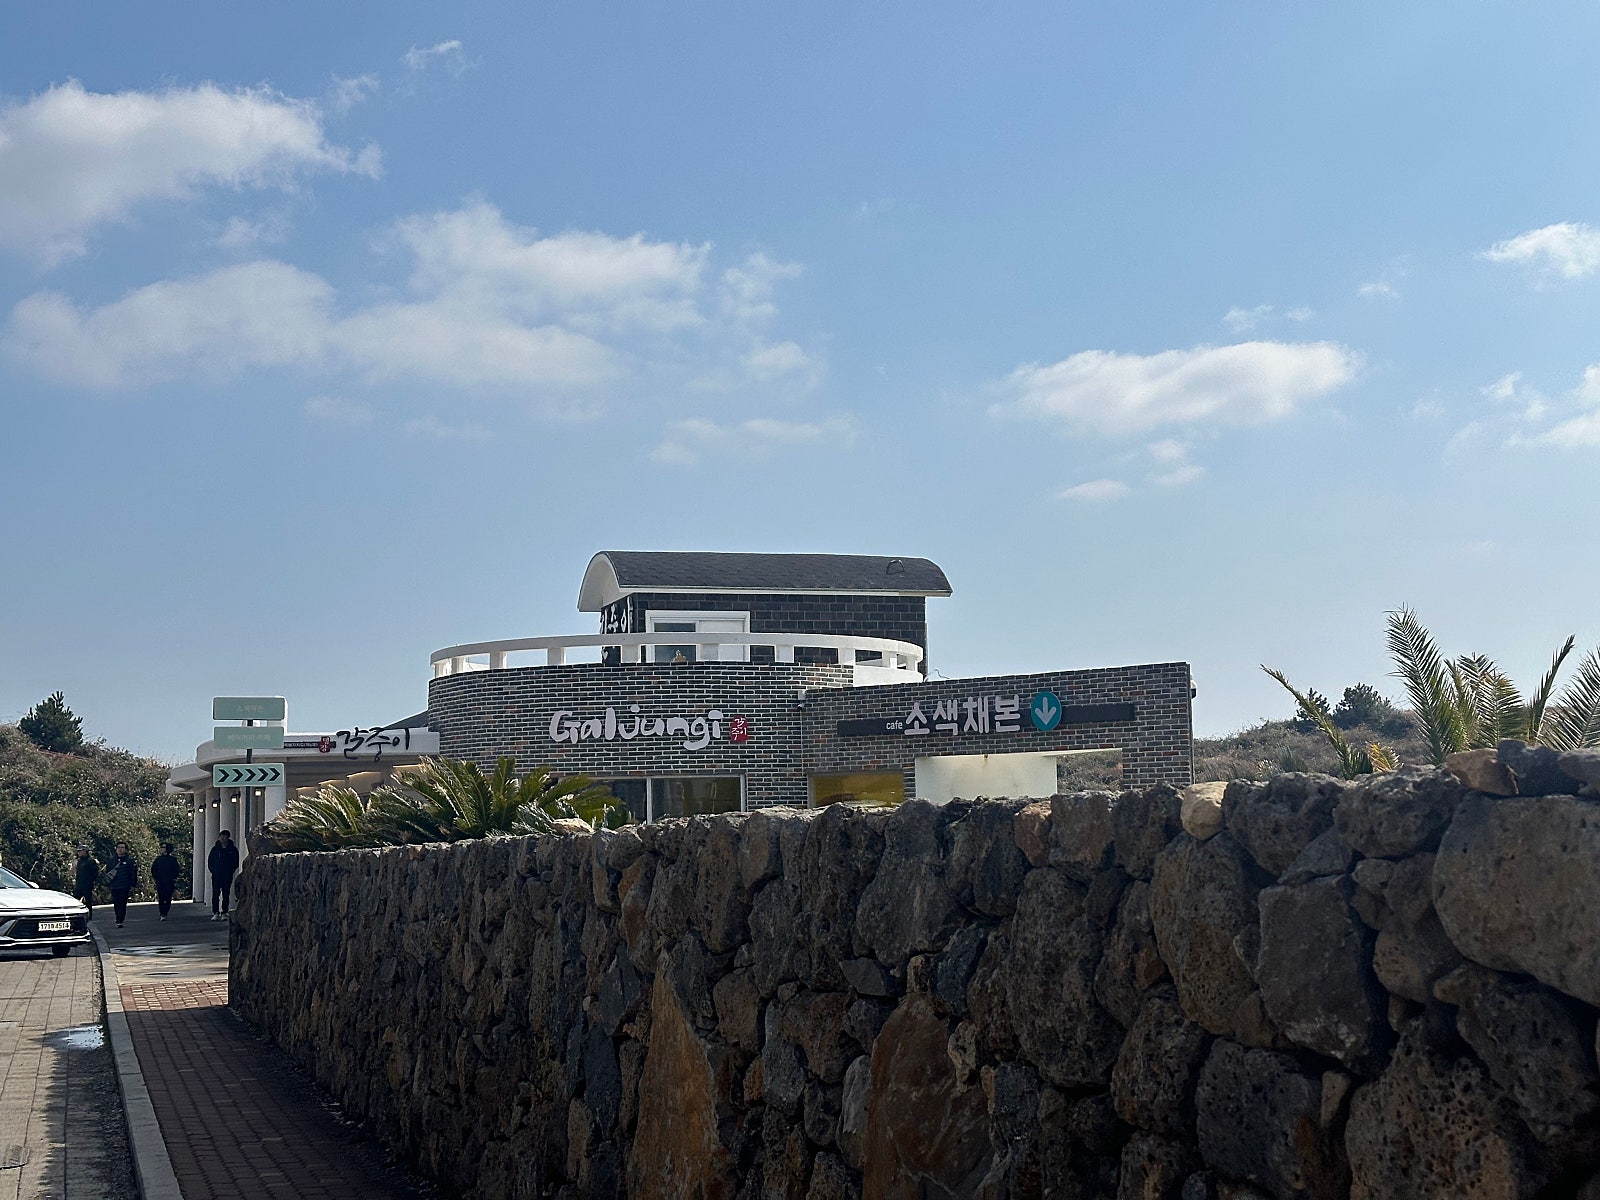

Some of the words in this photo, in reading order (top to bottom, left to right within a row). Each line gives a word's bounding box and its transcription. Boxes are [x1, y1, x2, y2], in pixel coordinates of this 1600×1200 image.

[549, 704, 724, 751] Galjungi
[885, 720, 904, 731] cafe
[903, 694, 1021, 737] 소색채본
